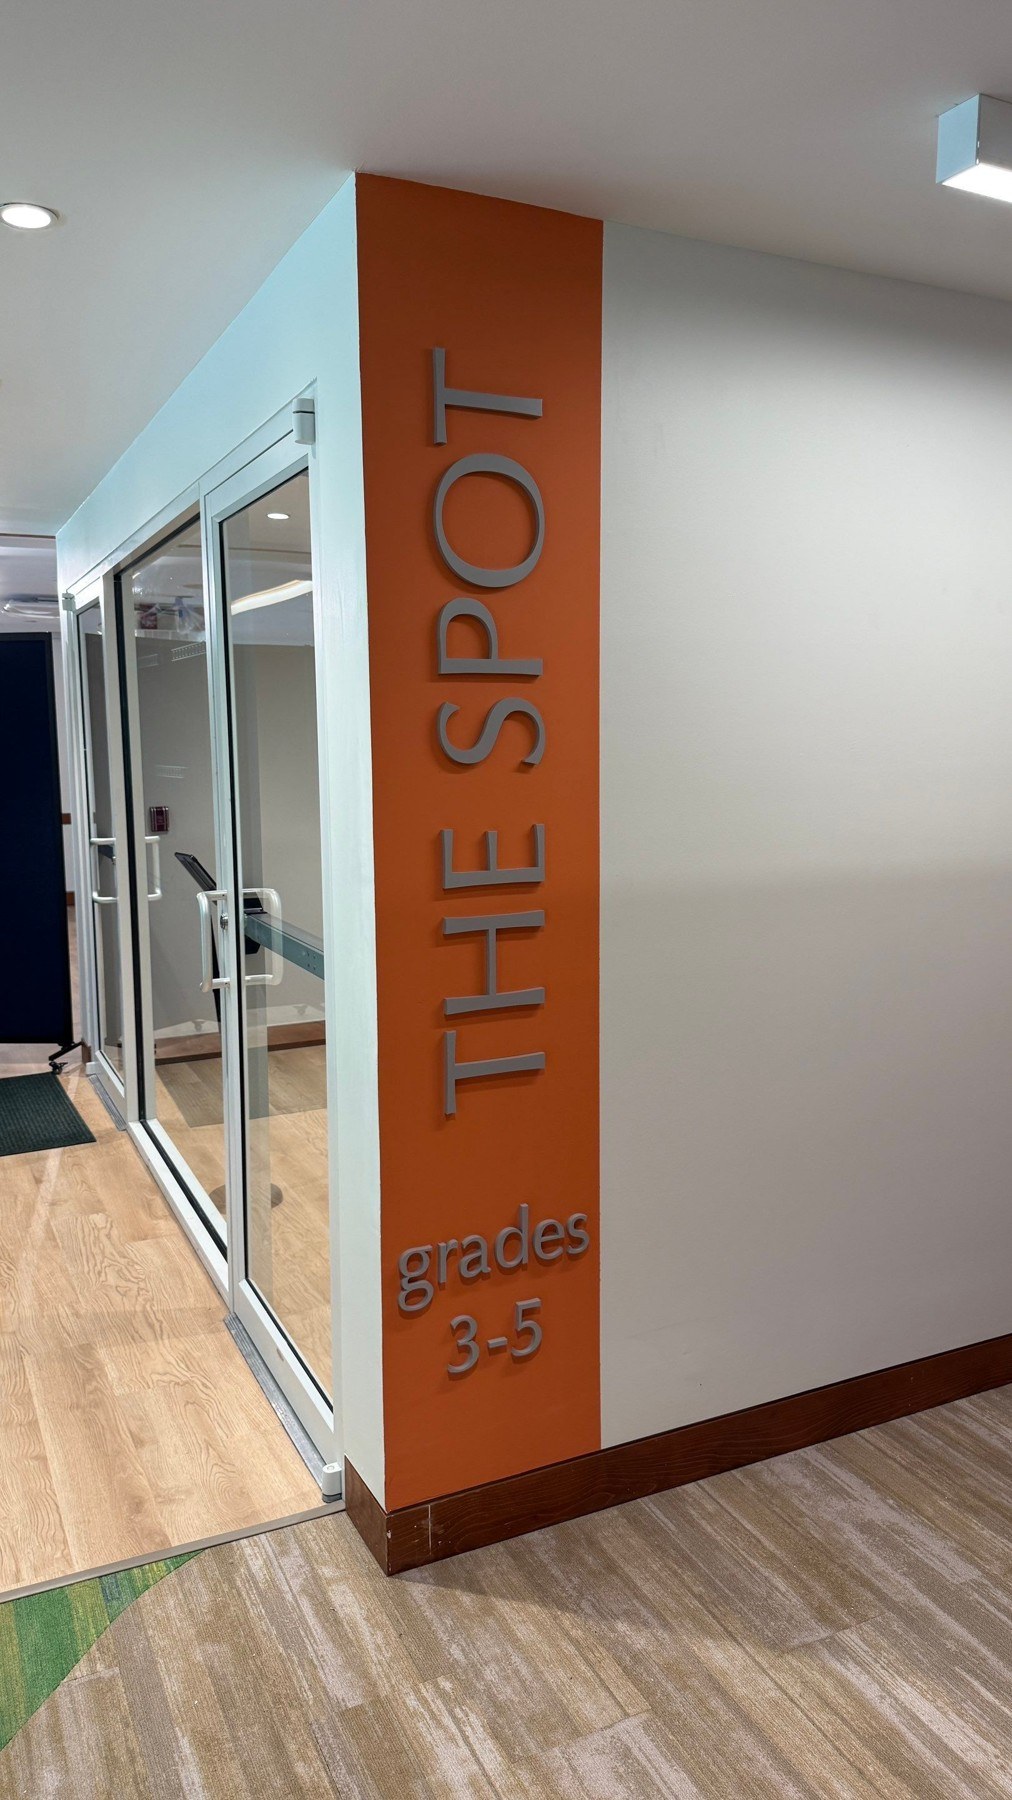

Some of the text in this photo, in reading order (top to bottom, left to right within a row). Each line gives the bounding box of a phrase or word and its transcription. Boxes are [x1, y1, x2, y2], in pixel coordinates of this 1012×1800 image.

[431, 346, 546, 1116] THE SPOT
[397, 1203, 590, 1312] grades
[447, 1298, 543, 1374] 3-5
